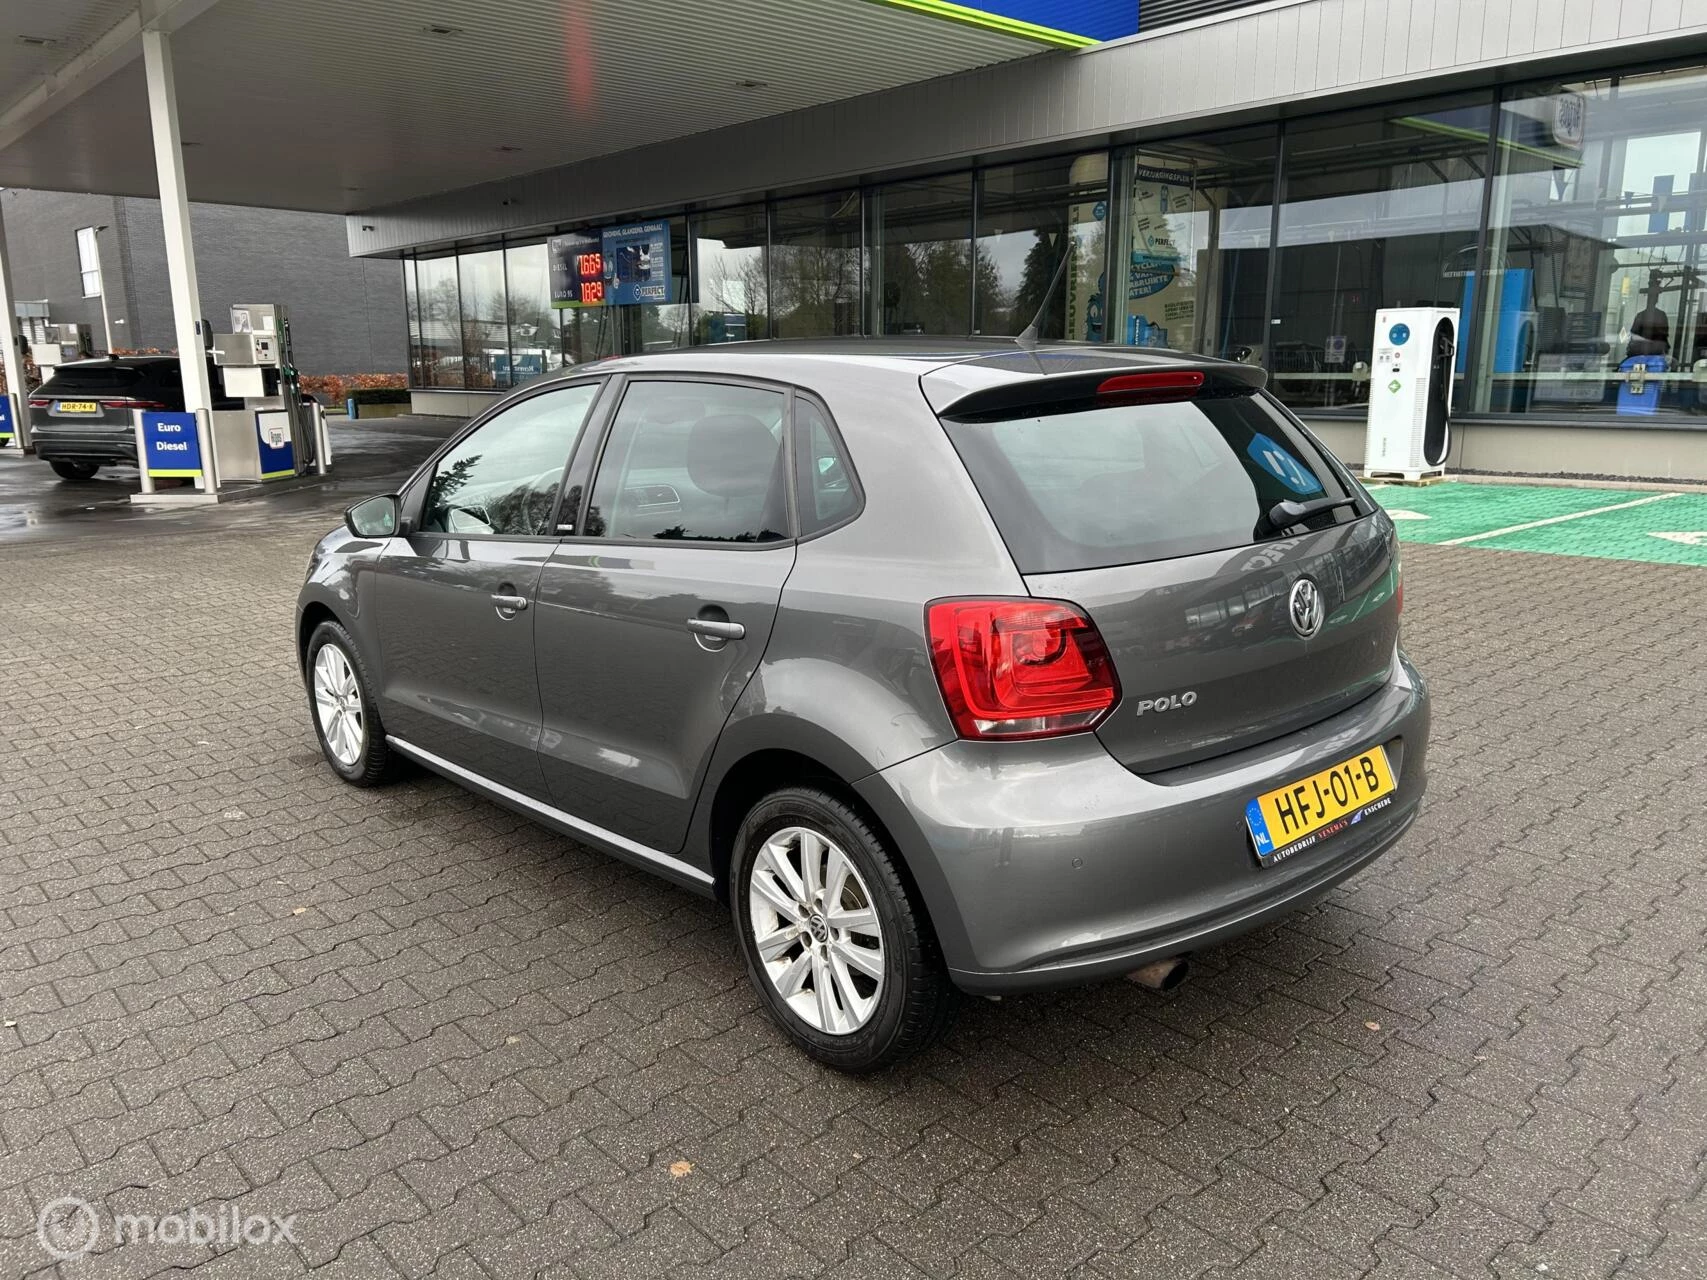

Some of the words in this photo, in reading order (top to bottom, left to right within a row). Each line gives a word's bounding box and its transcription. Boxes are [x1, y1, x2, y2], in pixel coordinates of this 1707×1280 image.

[581, 281, 602, 303] 1829
[1129, 286, 1152, 298] ATER!
[157, 423, 181, 432] Euro
[156, 441, 187, 450] Diesel
[1136, 690, 1198, 717] POLO
[1274, 756, 1379, 835] HFJ-01-B
[1255, 831, 1269, 846] NL
[1272, 835, 1316, 863] AUTOBEDRIJF
[1363, 797, 1392, 816] ENSCHEDE
